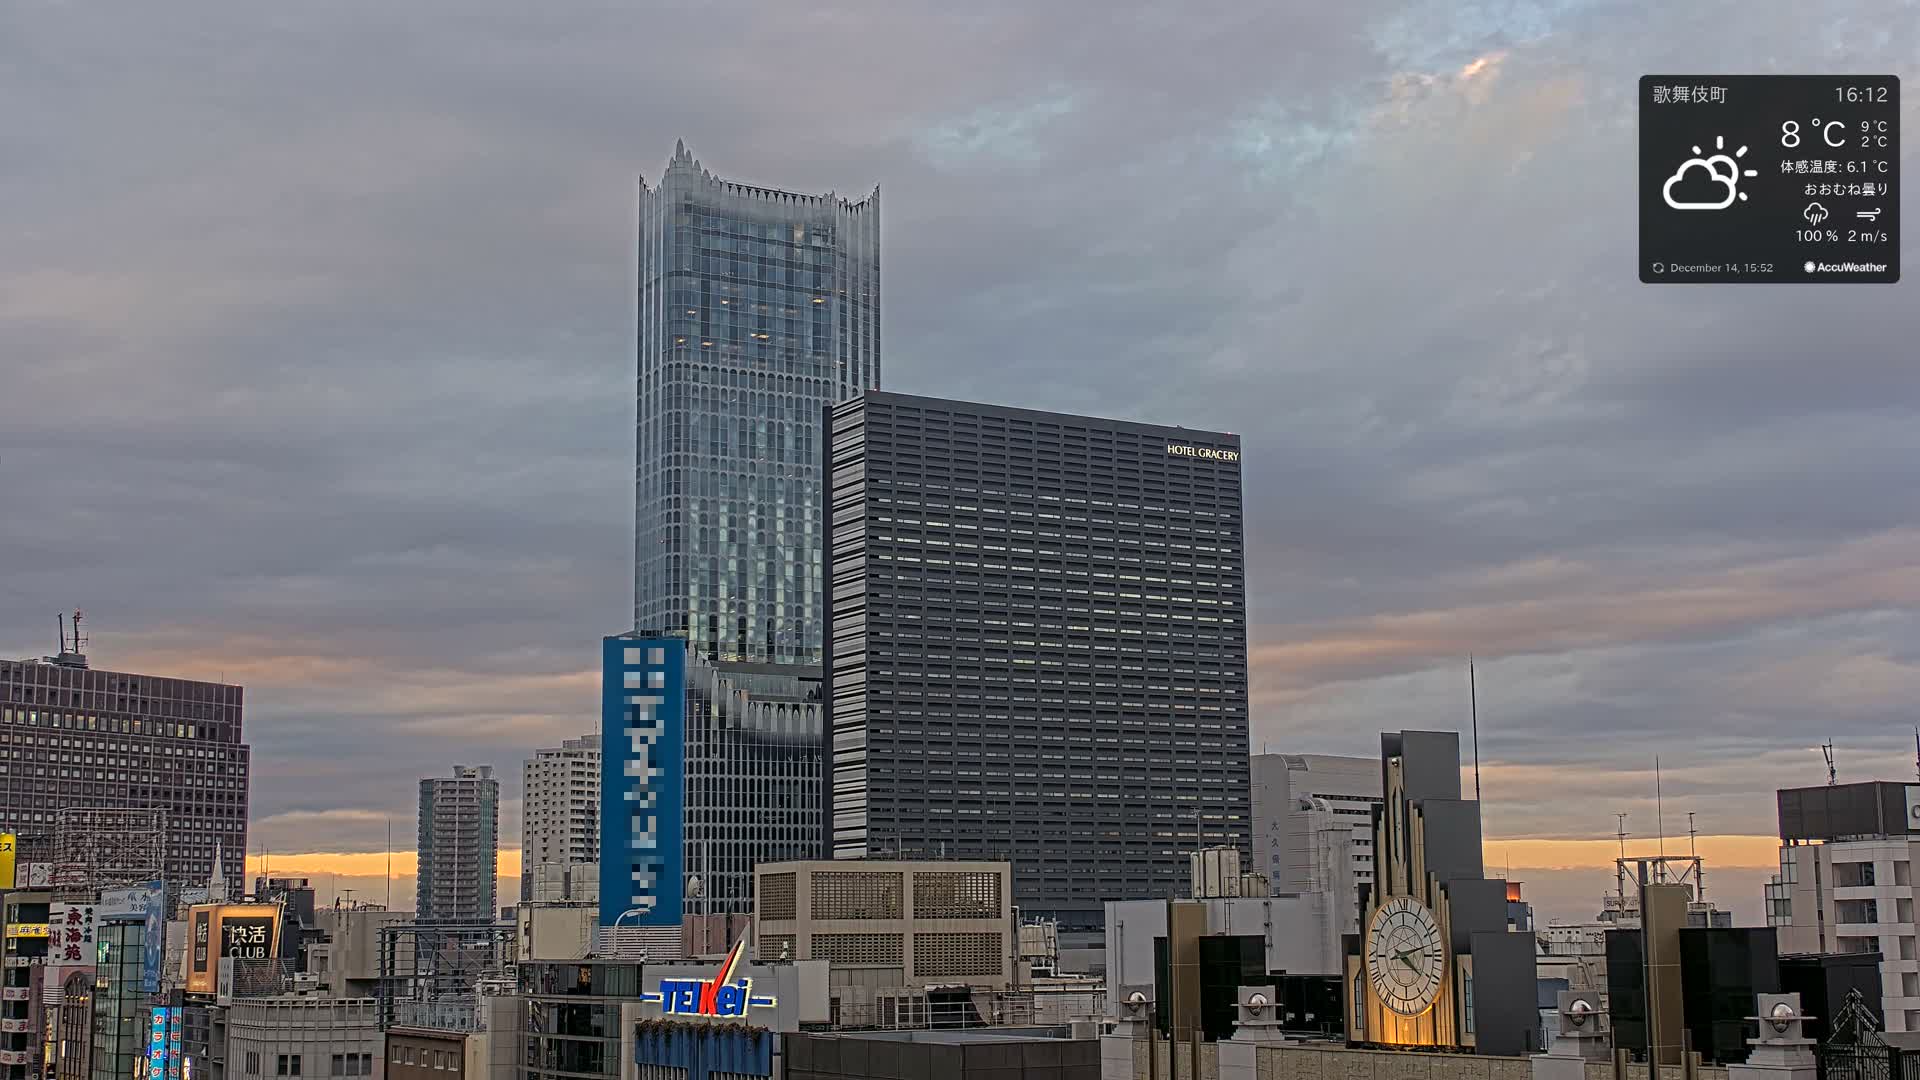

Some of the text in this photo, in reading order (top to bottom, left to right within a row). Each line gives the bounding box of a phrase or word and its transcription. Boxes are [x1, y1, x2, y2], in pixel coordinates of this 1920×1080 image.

[1167, 444, 1240, 461] HOTEL GRACERY
[231, 925, 267, 944] 快活
[229, 946, 265, 959] CLUB
[152, 1015, 164, 1077] カラオケ
